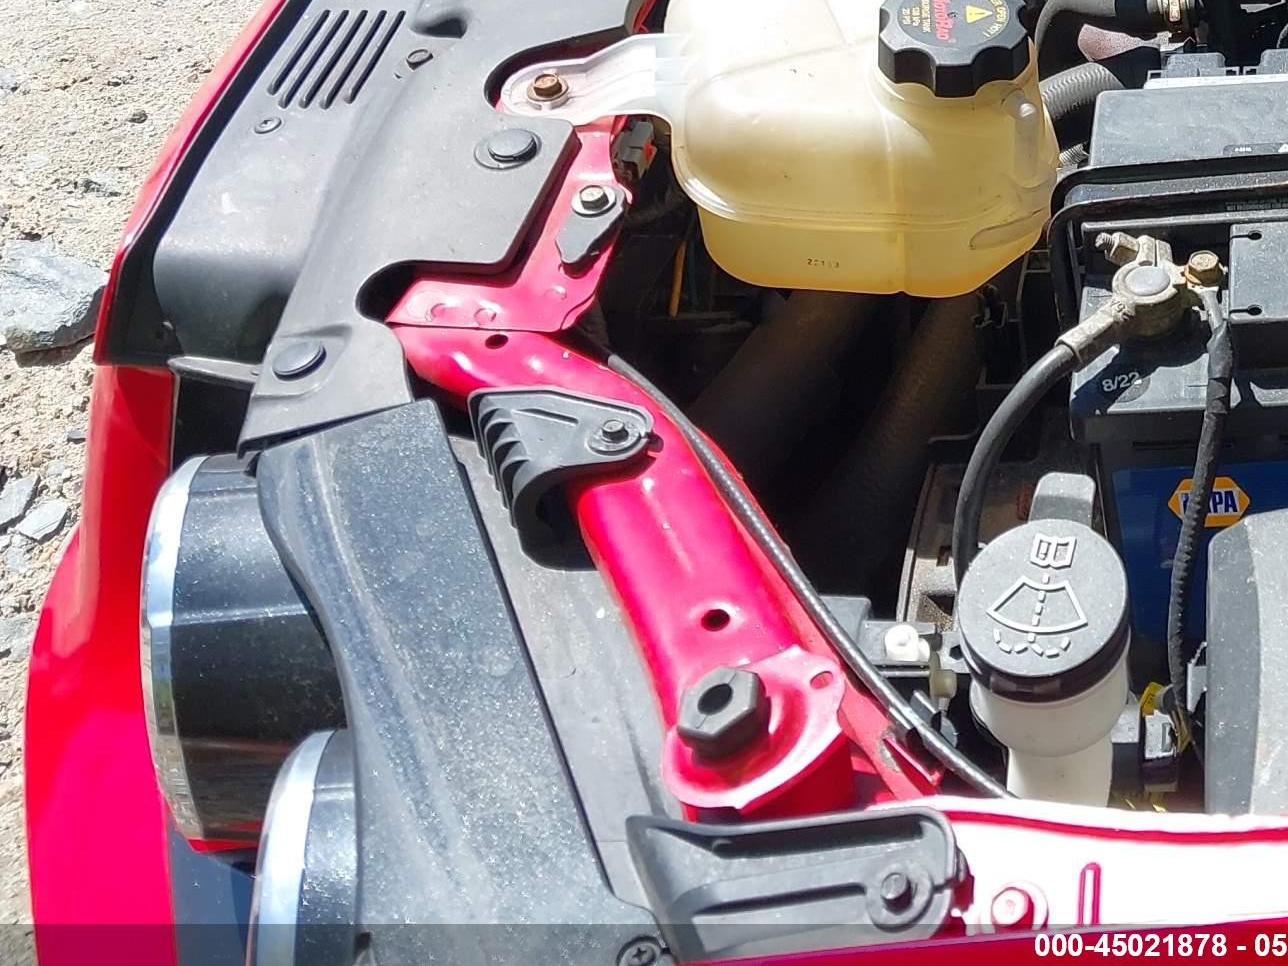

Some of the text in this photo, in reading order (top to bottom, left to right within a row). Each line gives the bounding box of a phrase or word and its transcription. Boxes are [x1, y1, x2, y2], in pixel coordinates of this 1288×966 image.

[996, 6, 1007, 24] OPEN
[922, 18, 932, 33] TANK
[989, 23, 1002, 36] HOT
[1101, 371, 1143, 392] 8/22
[1181, 490, 1239, 514] NPA
